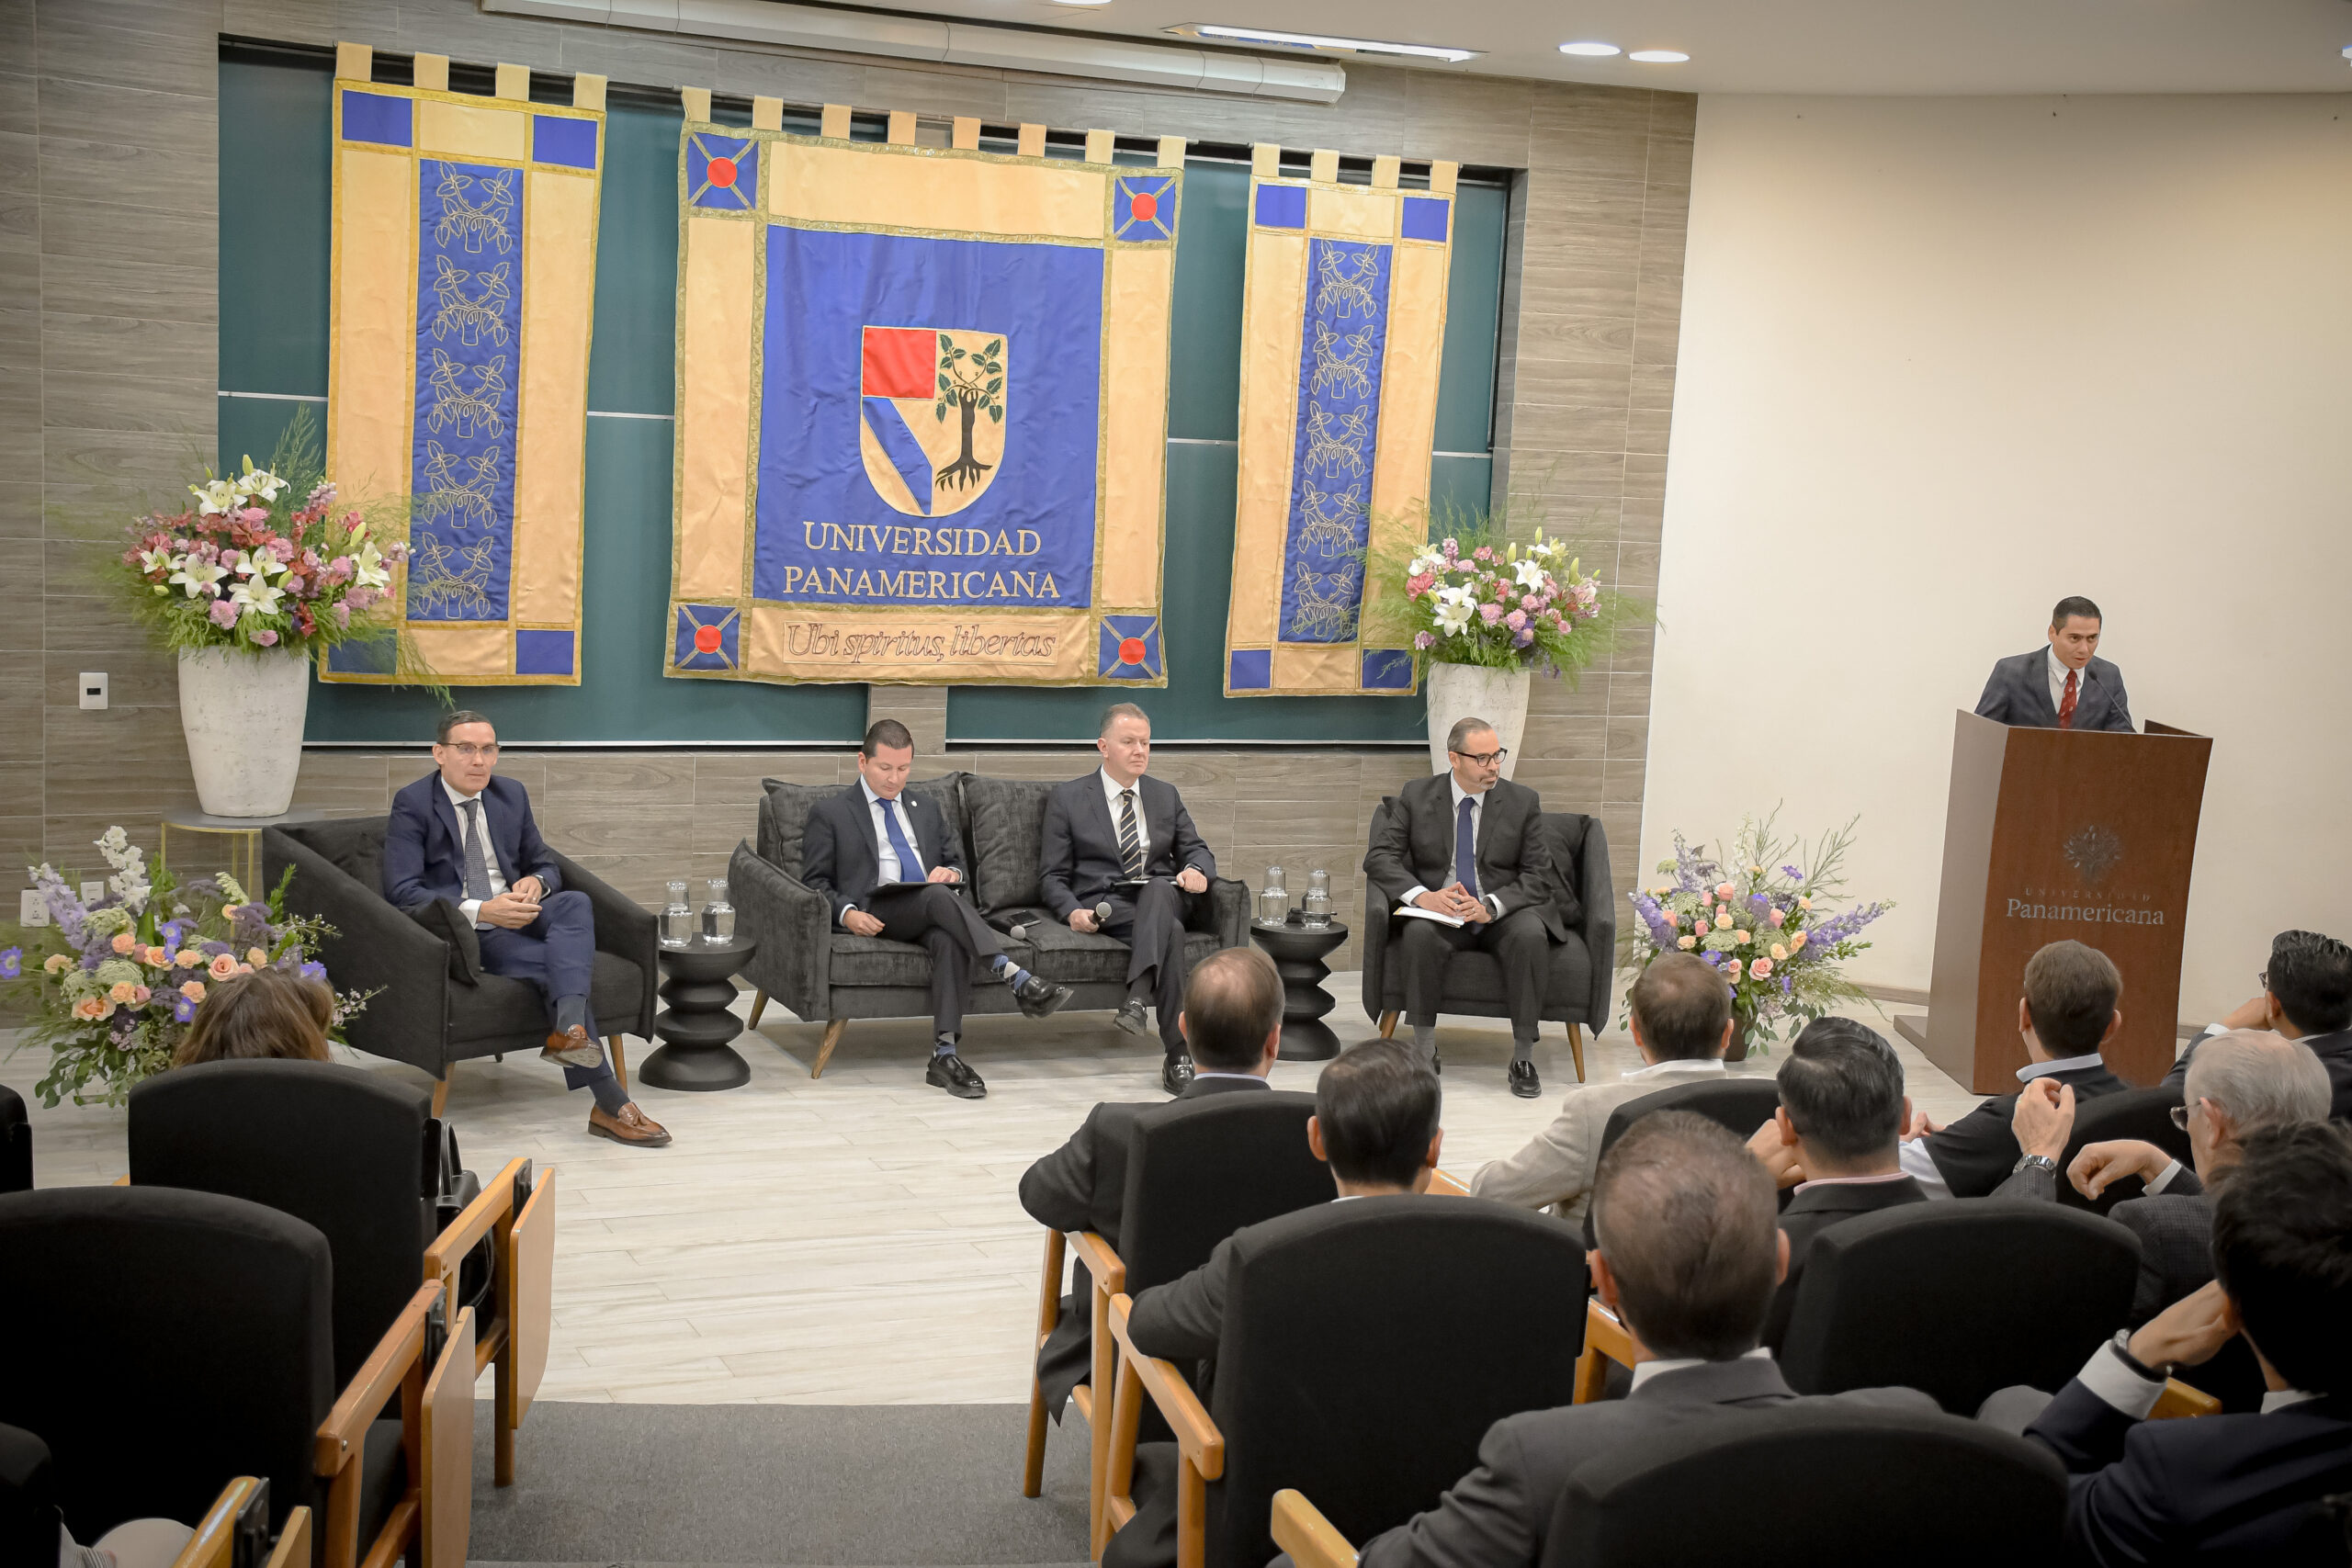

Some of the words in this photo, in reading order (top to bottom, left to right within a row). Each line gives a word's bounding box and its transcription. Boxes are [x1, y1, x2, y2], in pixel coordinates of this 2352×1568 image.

[802, 521, 1042, 556] UNIVERSIDAD
[783, 566, 1061, 599] PANAMERICANA
[787, 623, 840, 657] Ubi
[842, 627, 945, 663] spiritus,
[949, 625, 1056, 658] libertas
[2006, 897, 2165, 925] Panamericana
